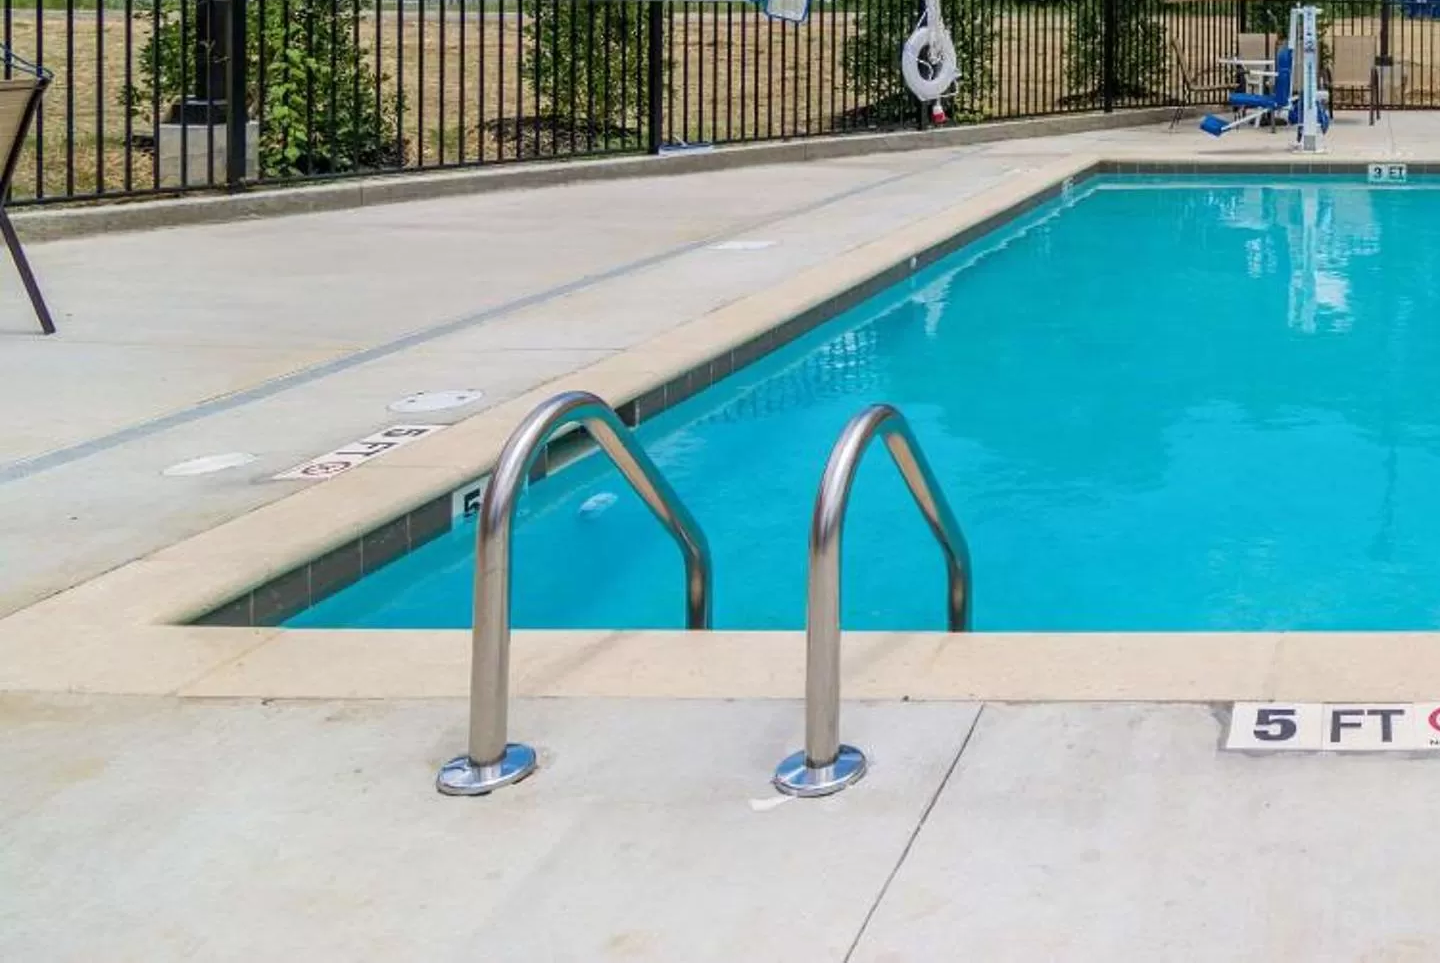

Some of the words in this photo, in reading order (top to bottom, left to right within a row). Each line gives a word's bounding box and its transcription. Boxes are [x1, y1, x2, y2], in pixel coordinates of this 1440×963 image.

[382, 428, 430, 437] 5
[336, 442, 398, 456] FT
[1253, 708, 1297, 741] 5
[1330, 709, 1405, 743] FT
